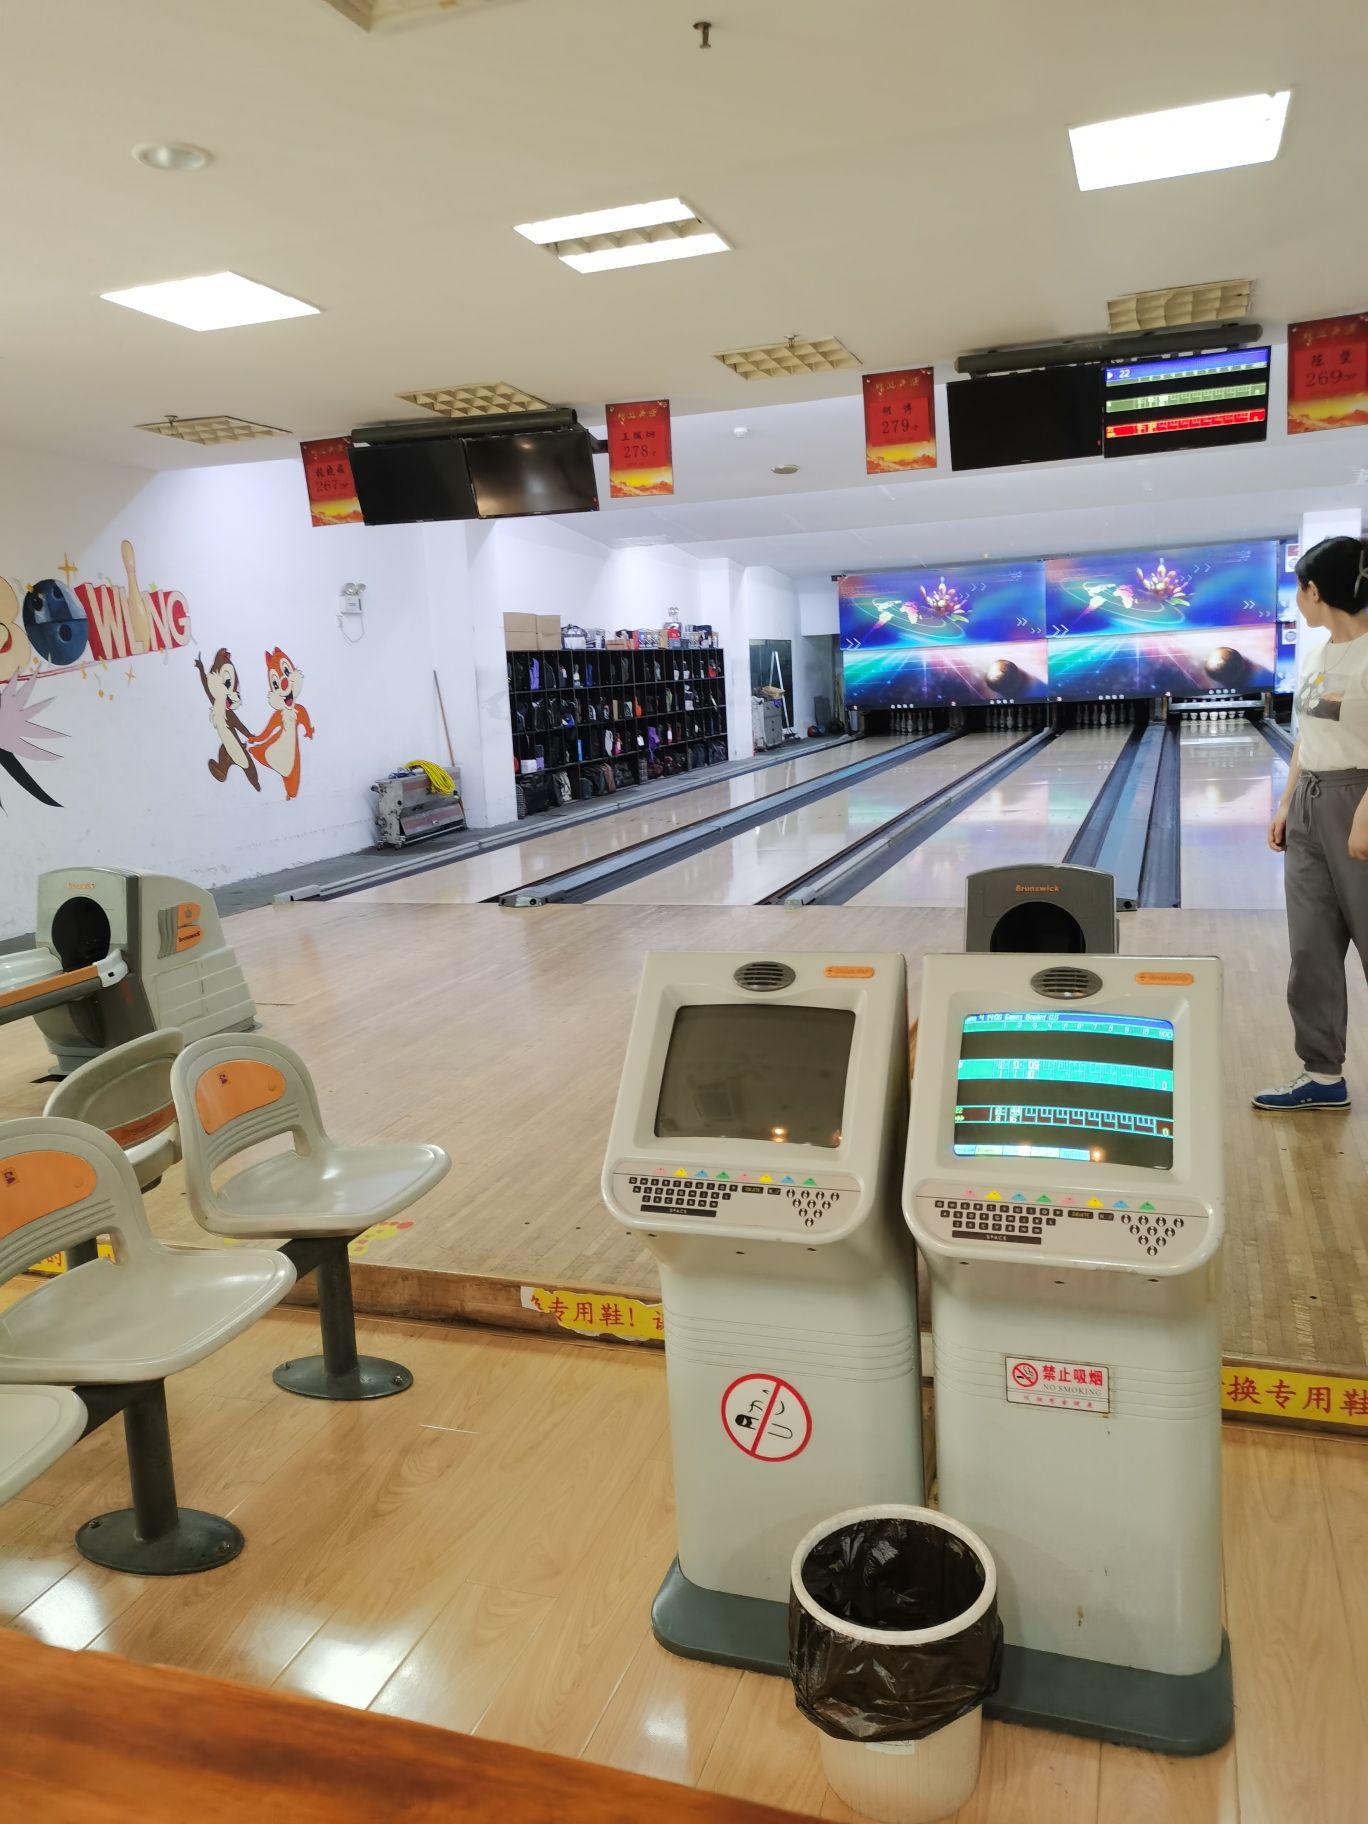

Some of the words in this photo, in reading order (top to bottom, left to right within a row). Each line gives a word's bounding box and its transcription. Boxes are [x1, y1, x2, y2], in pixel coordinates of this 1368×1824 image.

[1015, 884, 1061, 893] Brunswick
[1042, 1364, 1103, 1387] 禁止吸烟
[1058, 1385, 1103, 1396] SMOKING
